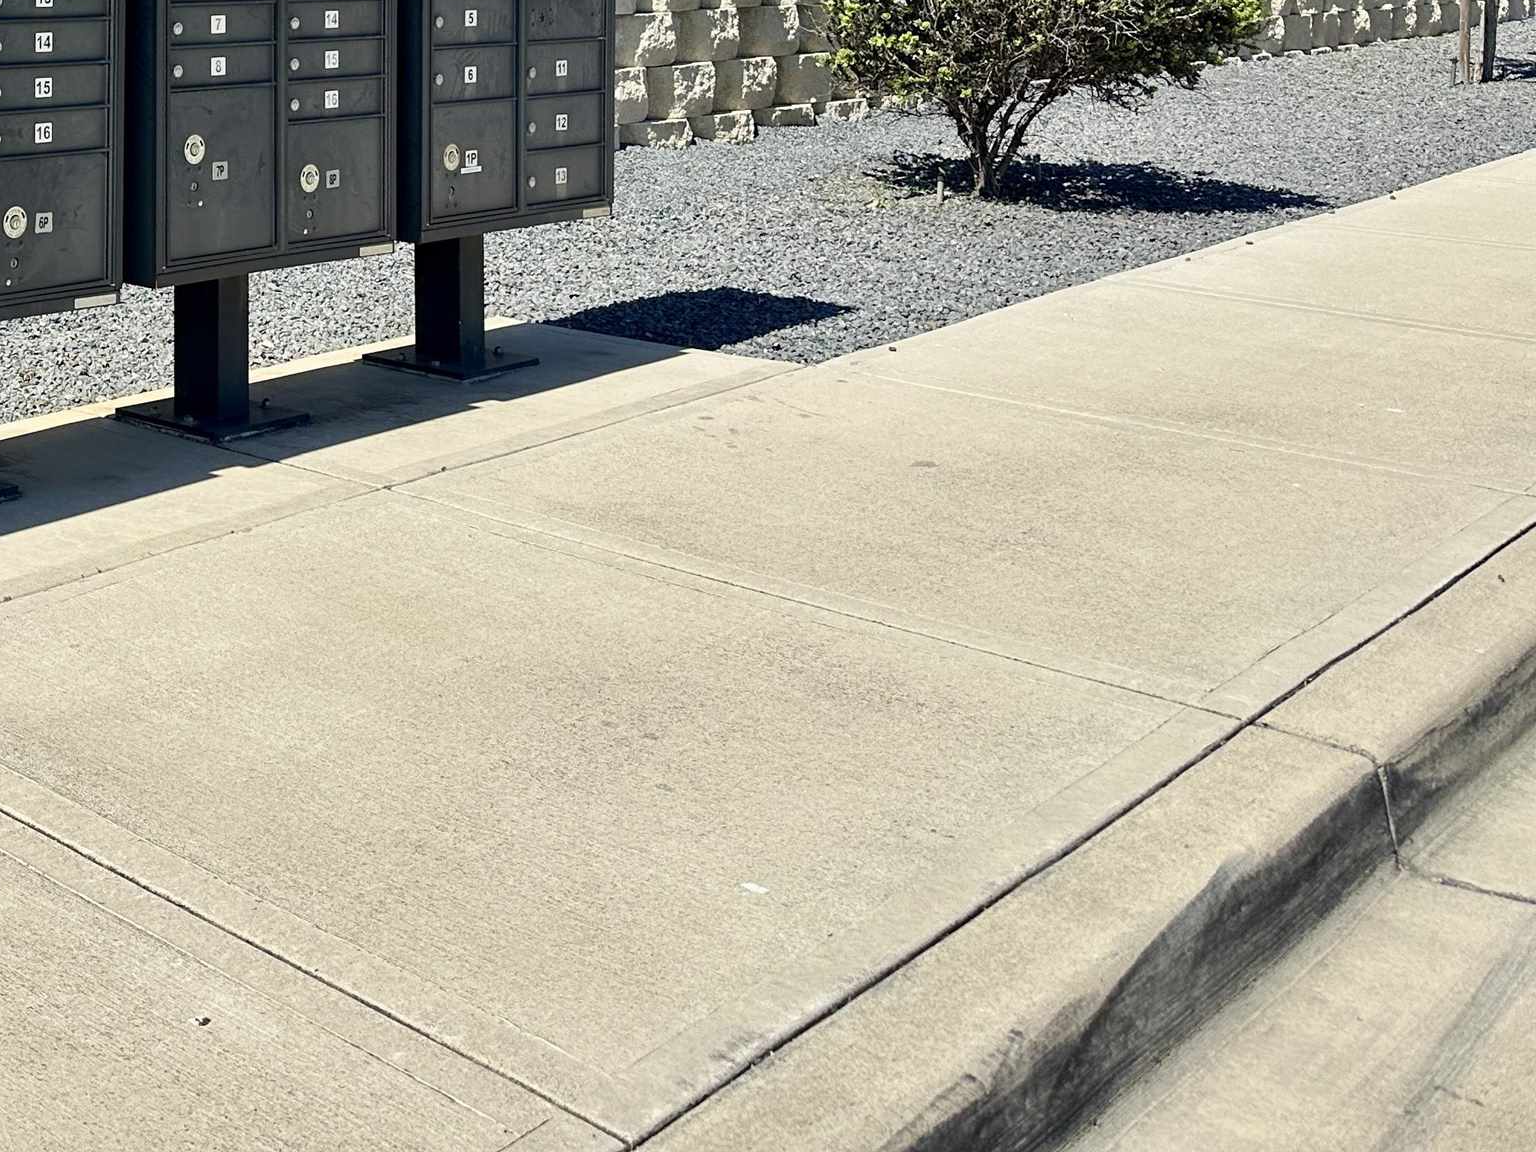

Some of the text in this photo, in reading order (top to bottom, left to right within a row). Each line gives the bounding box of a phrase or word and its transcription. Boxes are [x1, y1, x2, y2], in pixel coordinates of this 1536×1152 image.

[37, 35, 51, 50] 14
[36, 80, 51, 95] 15
[36, 125, 51, 140] 16
[38, 216, 49, 229] 6P
